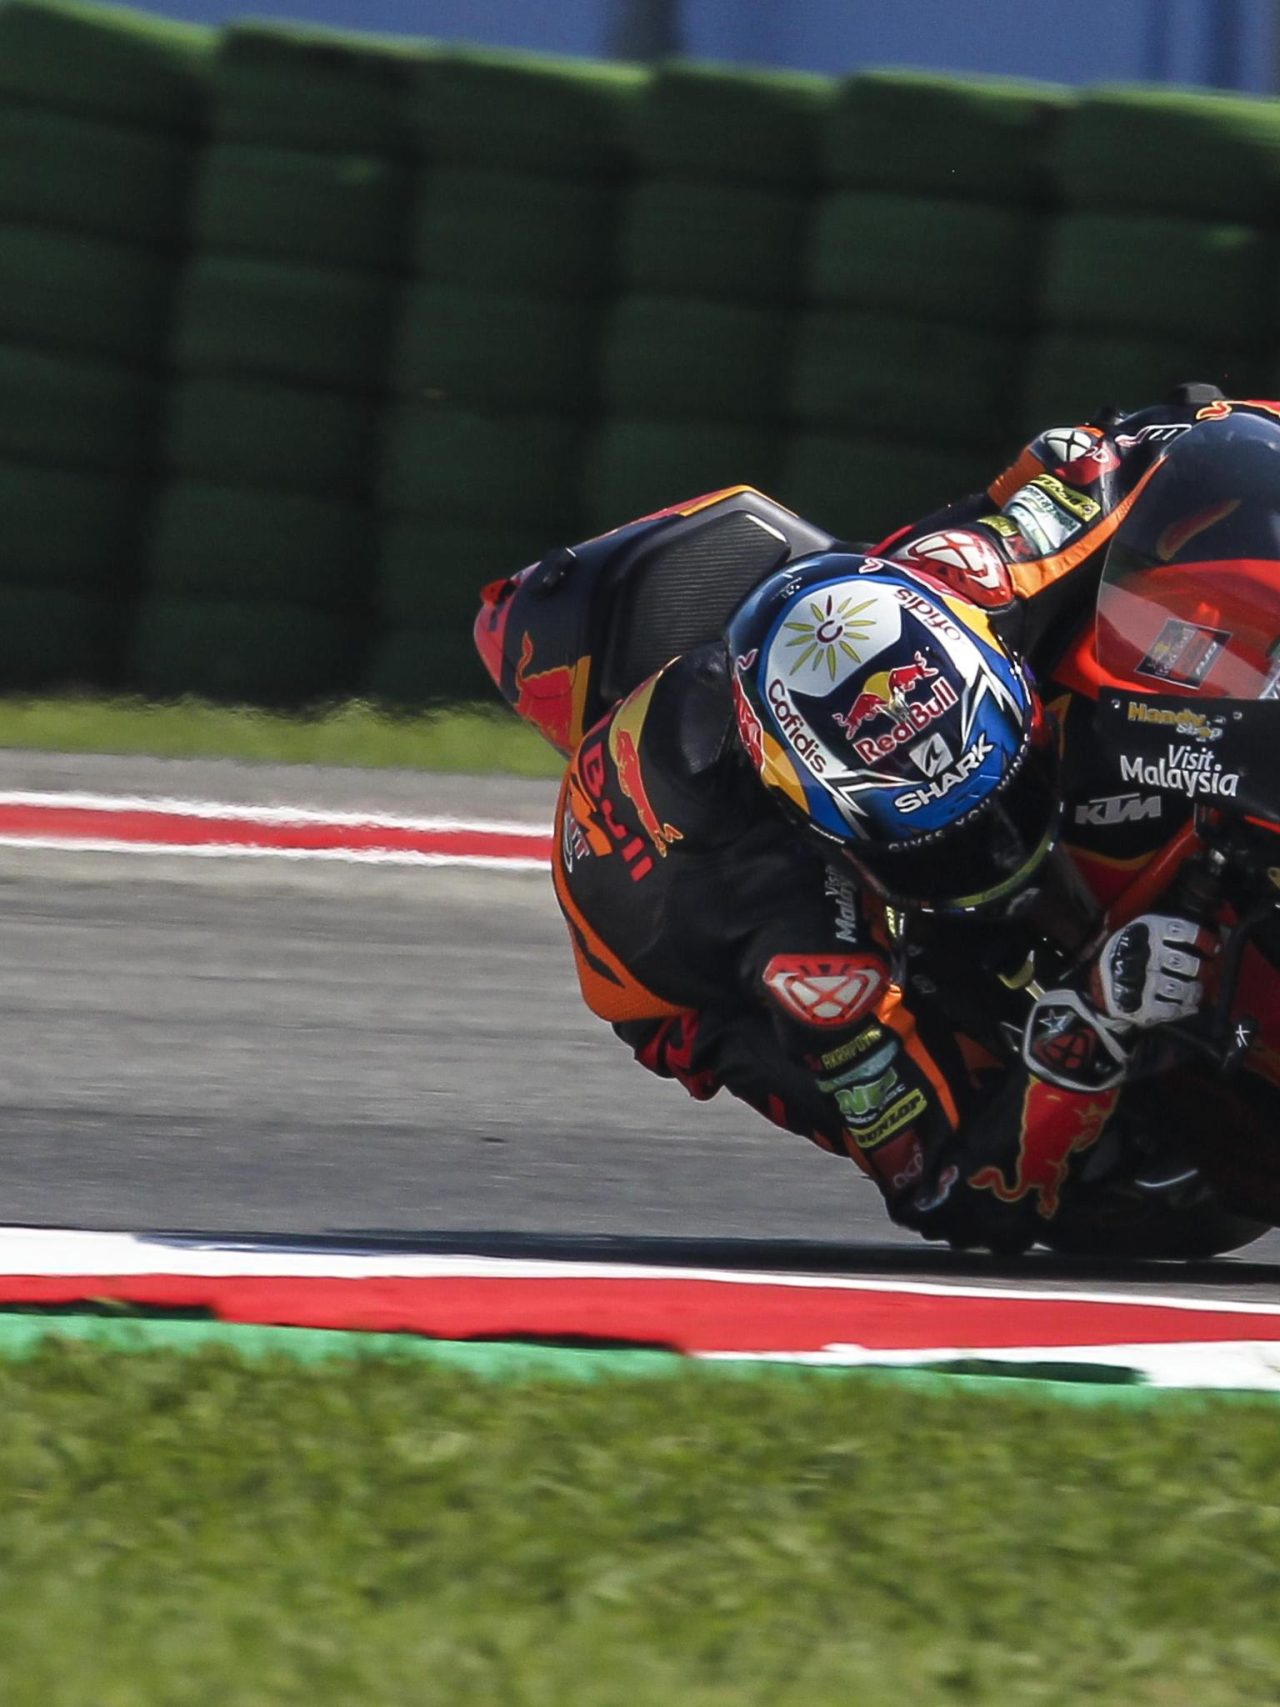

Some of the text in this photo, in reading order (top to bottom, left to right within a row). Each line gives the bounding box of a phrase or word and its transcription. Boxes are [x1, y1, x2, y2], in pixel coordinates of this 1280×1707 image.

[894, 588, 961, 642] ofidis
[768, 678, 827, 774] Cofidis
[853, 676, 959, 765] Red Bull
[894, 732, 994, 813] SHARK
[1120, 755, 1239, 797] Malaysia
[1168, 744, 1214, 771] Visit
[1075, 793, 1162, 825] KTM
